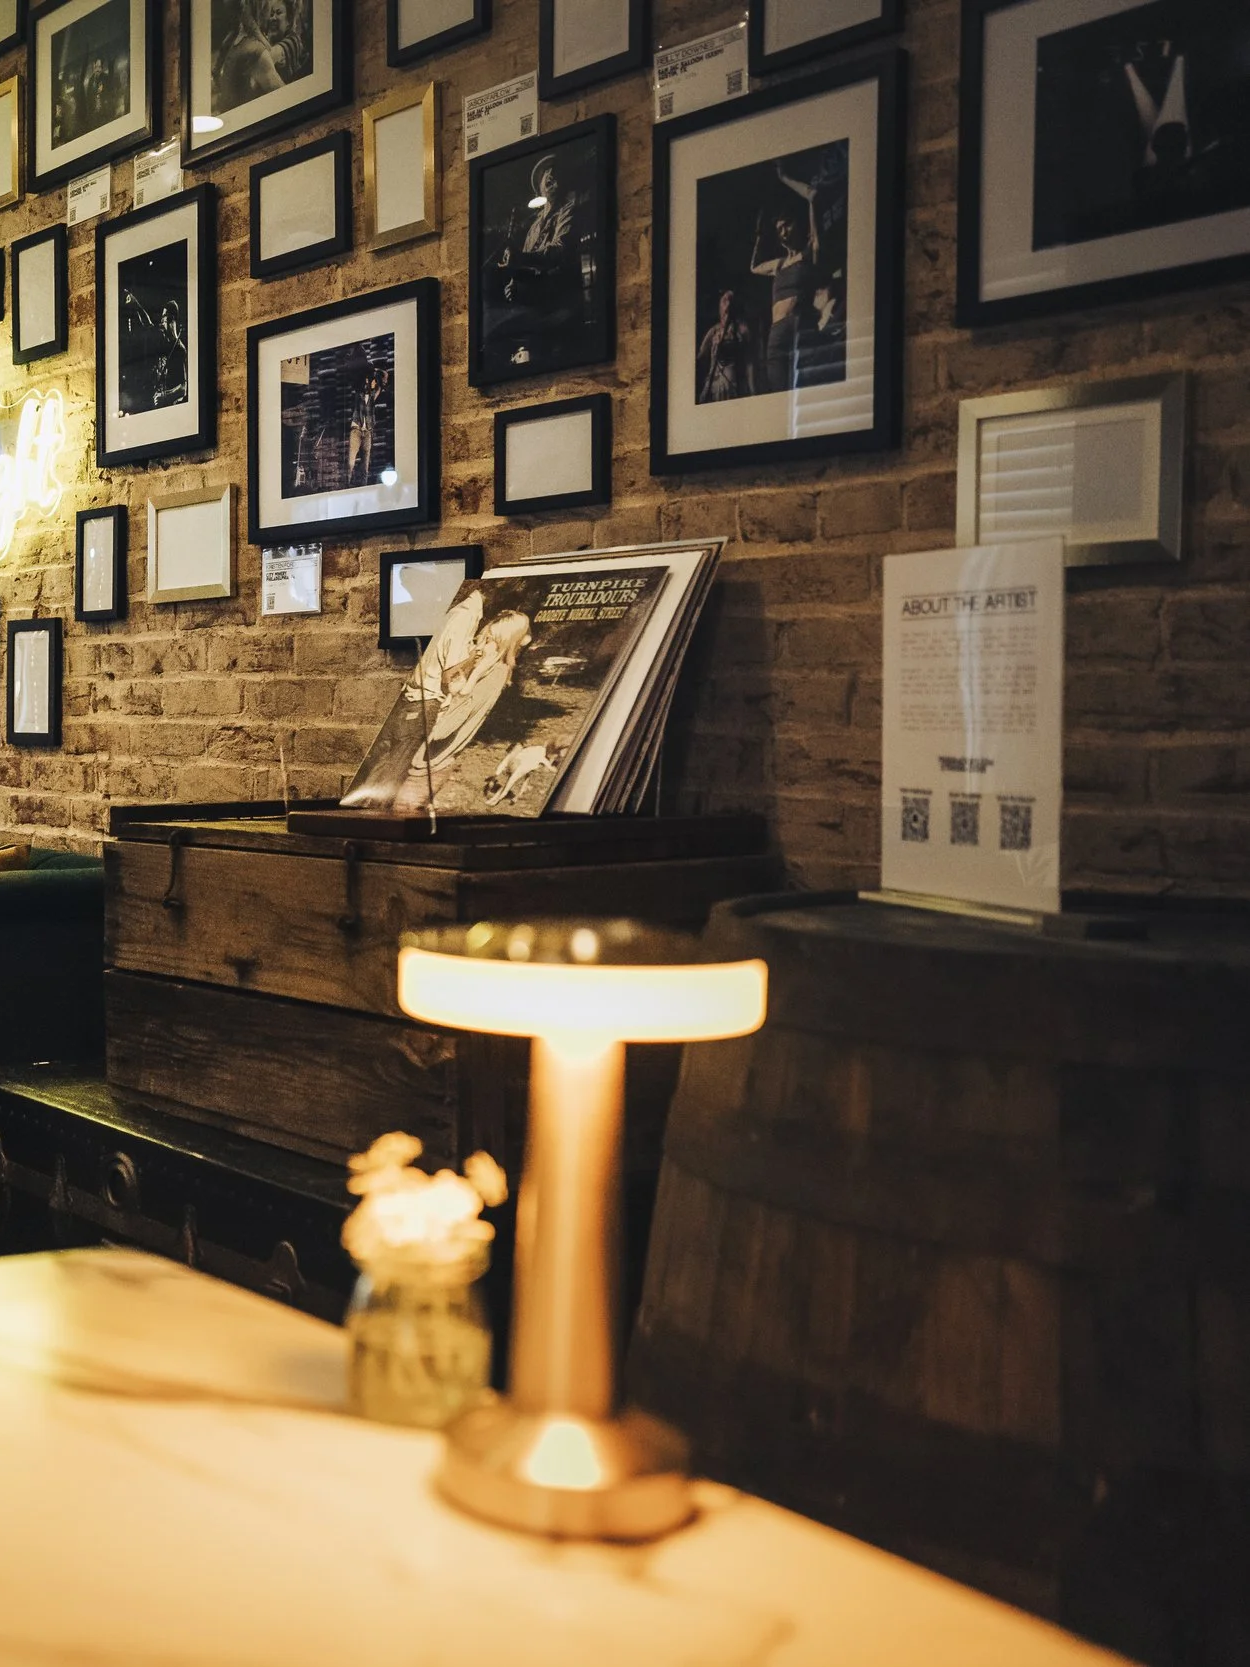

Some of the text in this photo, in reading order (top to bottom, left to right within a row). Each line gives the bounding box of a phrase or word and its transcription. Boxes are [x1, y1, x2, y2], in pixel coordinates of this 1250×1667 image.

[550, 578, 648, 593] TURNPIKE
[543, 588, 640, 607] TROUBADOURS
[902, 590, 1037, 616] ABOUT THE ARTIST
[596, 606, 628, 620] STREET
